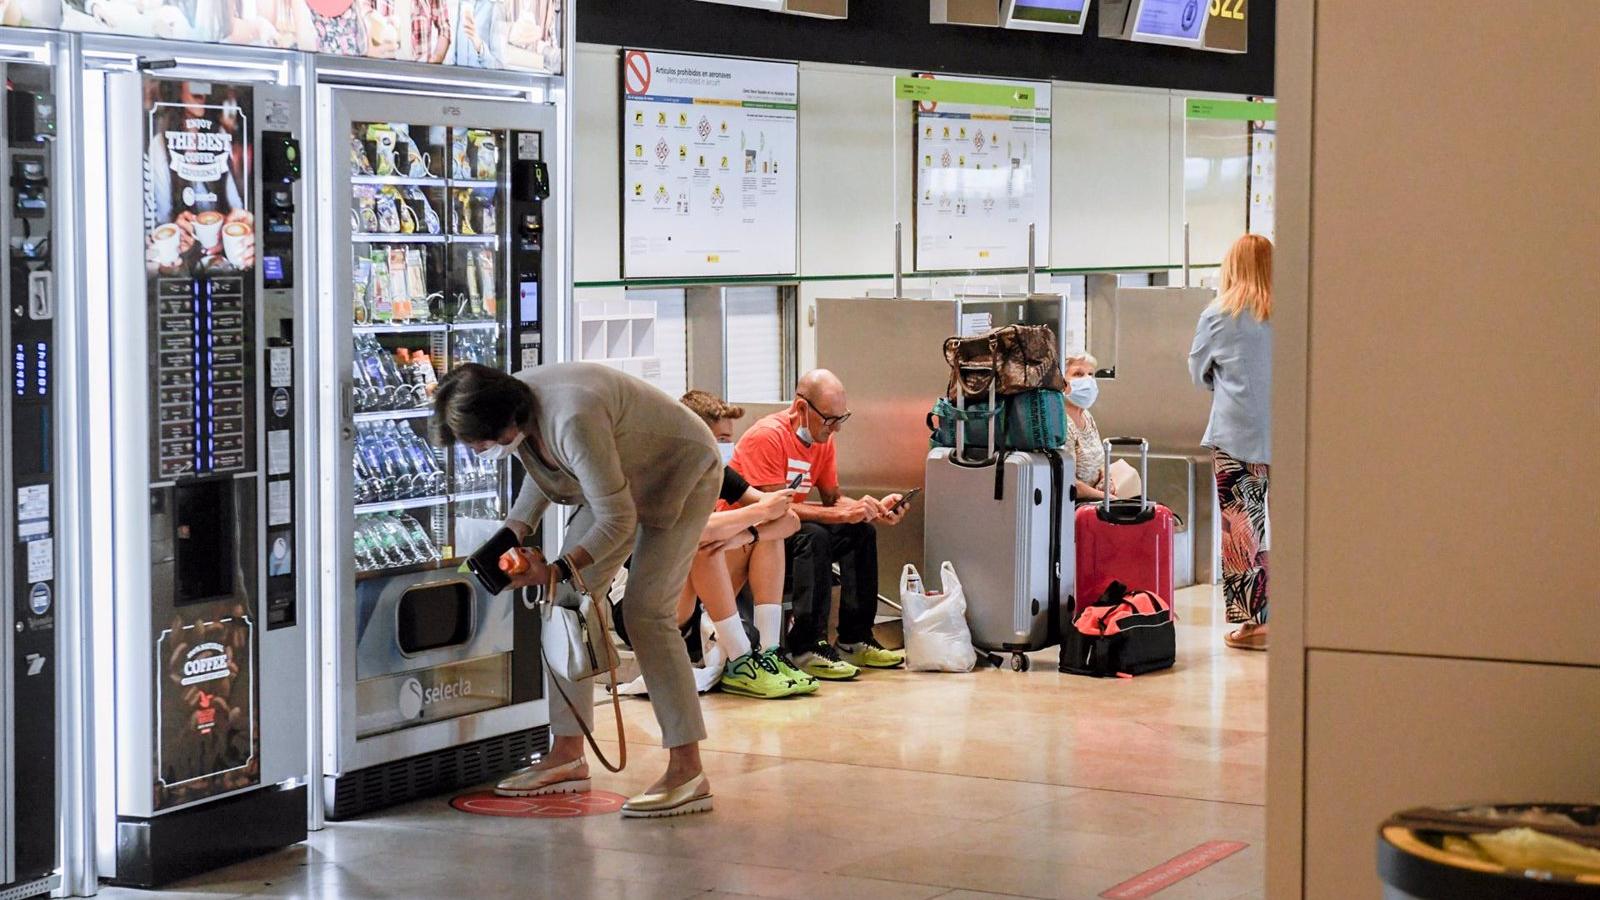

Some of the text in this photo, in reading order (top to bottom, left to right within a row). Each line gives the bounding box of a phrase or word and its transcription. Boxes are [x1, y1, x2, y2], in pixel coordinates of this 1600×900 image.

[677, 68, 701, 77] prohibidos
[185, 119, 213, 130] ENJOY
[165, 131, 232, 152] THE BEST
[183, 654, 228, 676] COFFEE
[424, 676, 472, 705] selecta
